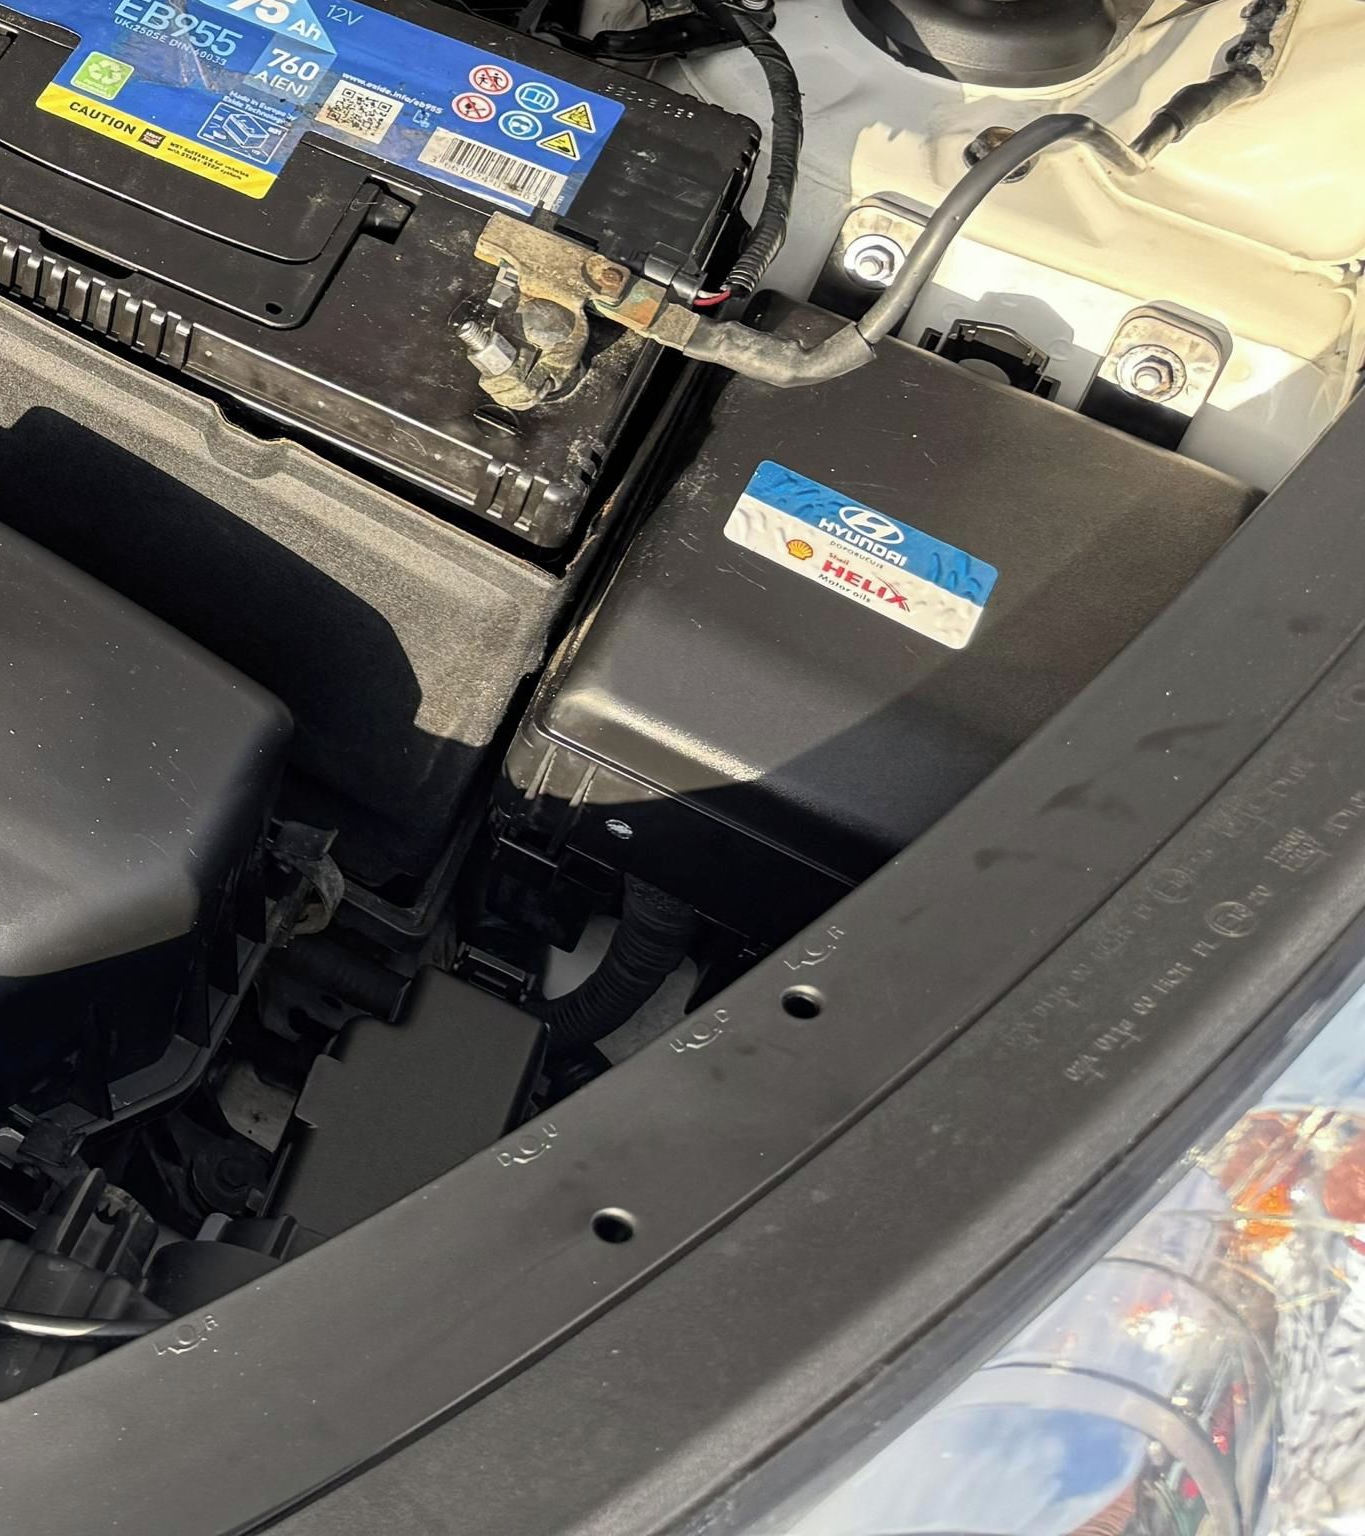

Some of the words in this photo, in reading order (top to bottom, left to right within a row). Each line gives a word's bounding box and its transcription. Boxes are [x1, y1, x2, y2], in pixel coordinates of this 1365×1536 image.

[287, 18, 322, 41] Ah
[325, 4, 364, 27] 12V
[267, 47, 320, 82] 760
[69, 101, 137, 136] CAUTION
[818, 517, 908, 567] HYUNDAI
[818, 573, 851, 592] Motor
[852, 591, 871, 603] oils
[821, 559, 910, 612] HELIX
